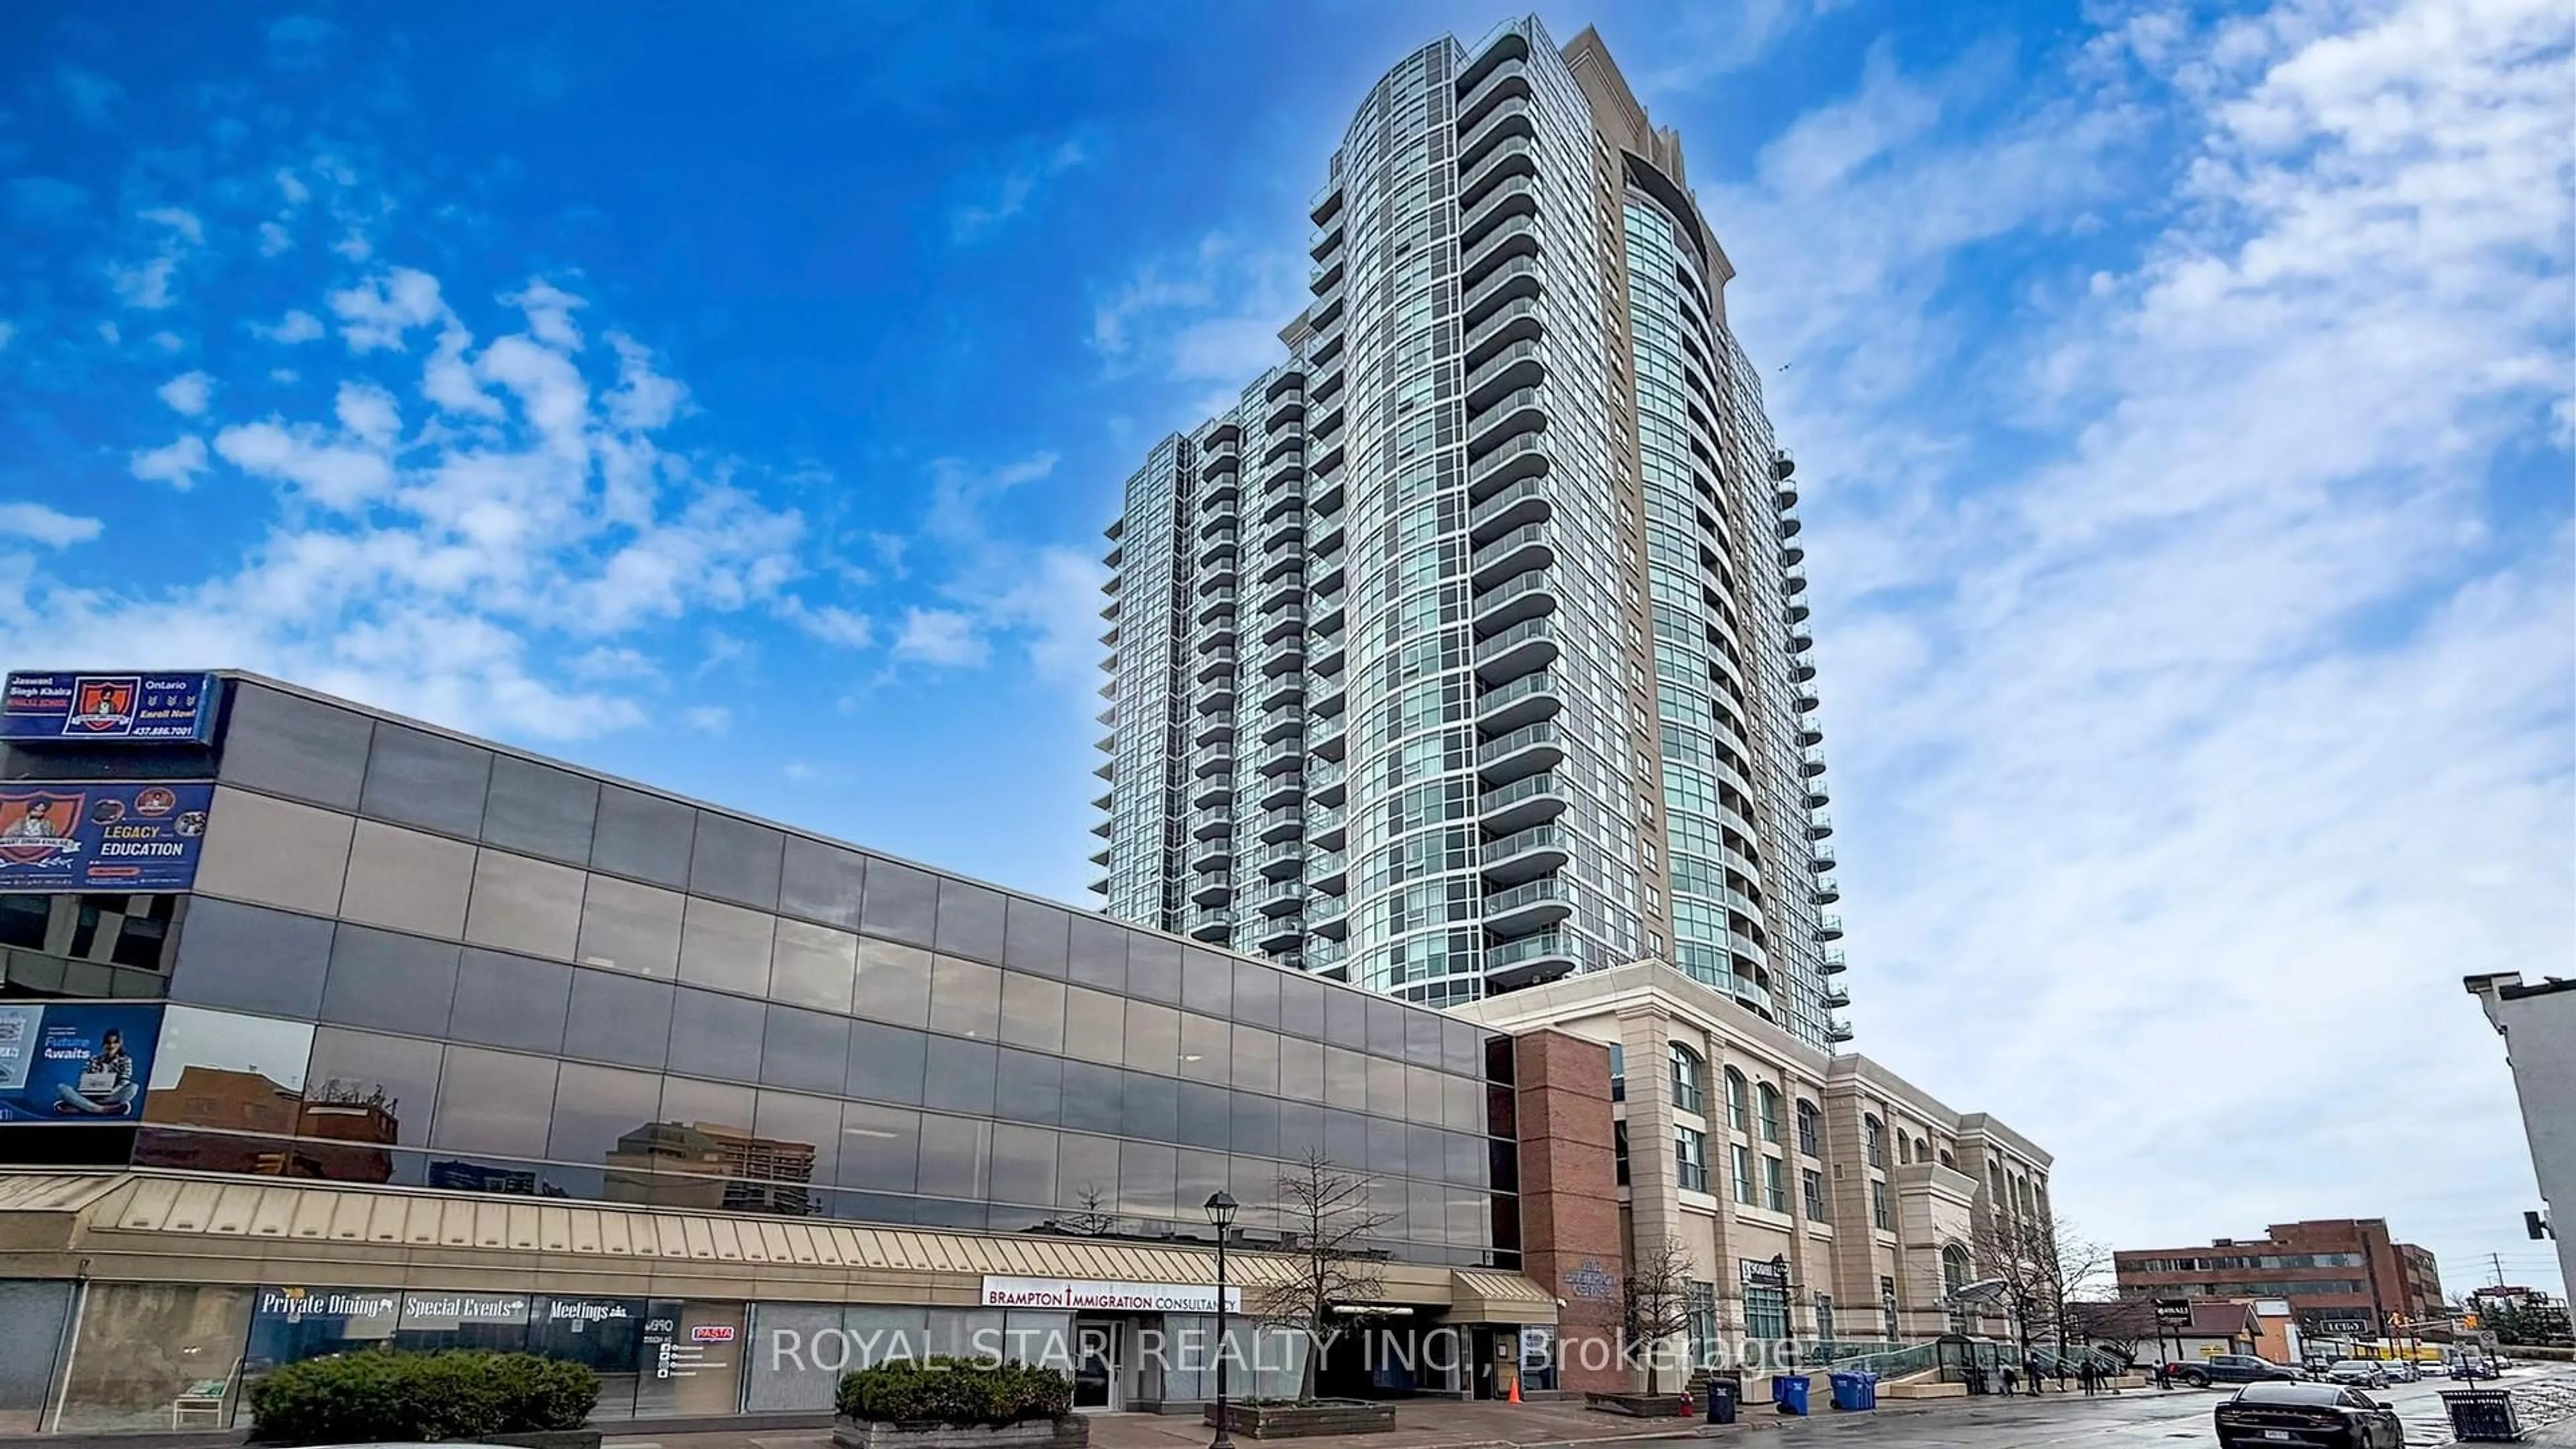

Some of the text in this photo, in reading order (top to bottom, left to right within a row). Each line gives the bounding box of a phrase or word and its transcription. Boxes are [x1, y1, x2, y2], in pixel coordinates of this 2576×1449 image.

[145, 680, 186, 690] Ontario
[10, 687, 38, 697] Singh
[103, 826, 160, 839] LEGACY
[101, 843, 183, 856] EDUCATION
[44, 1047, 91, 1059] Awaits
[989, 1291, 1063, 1306] BRAMPTON
[1065, 1284, 1152, 1308] IMMIGRATION
[262, 1293, 379, 1318] Private Dining
[406, 1297, 511, 1318] Special Events
[551, 1301, 608, 1322] Meetings
[696, 1329, 731, 1339] PASTA
